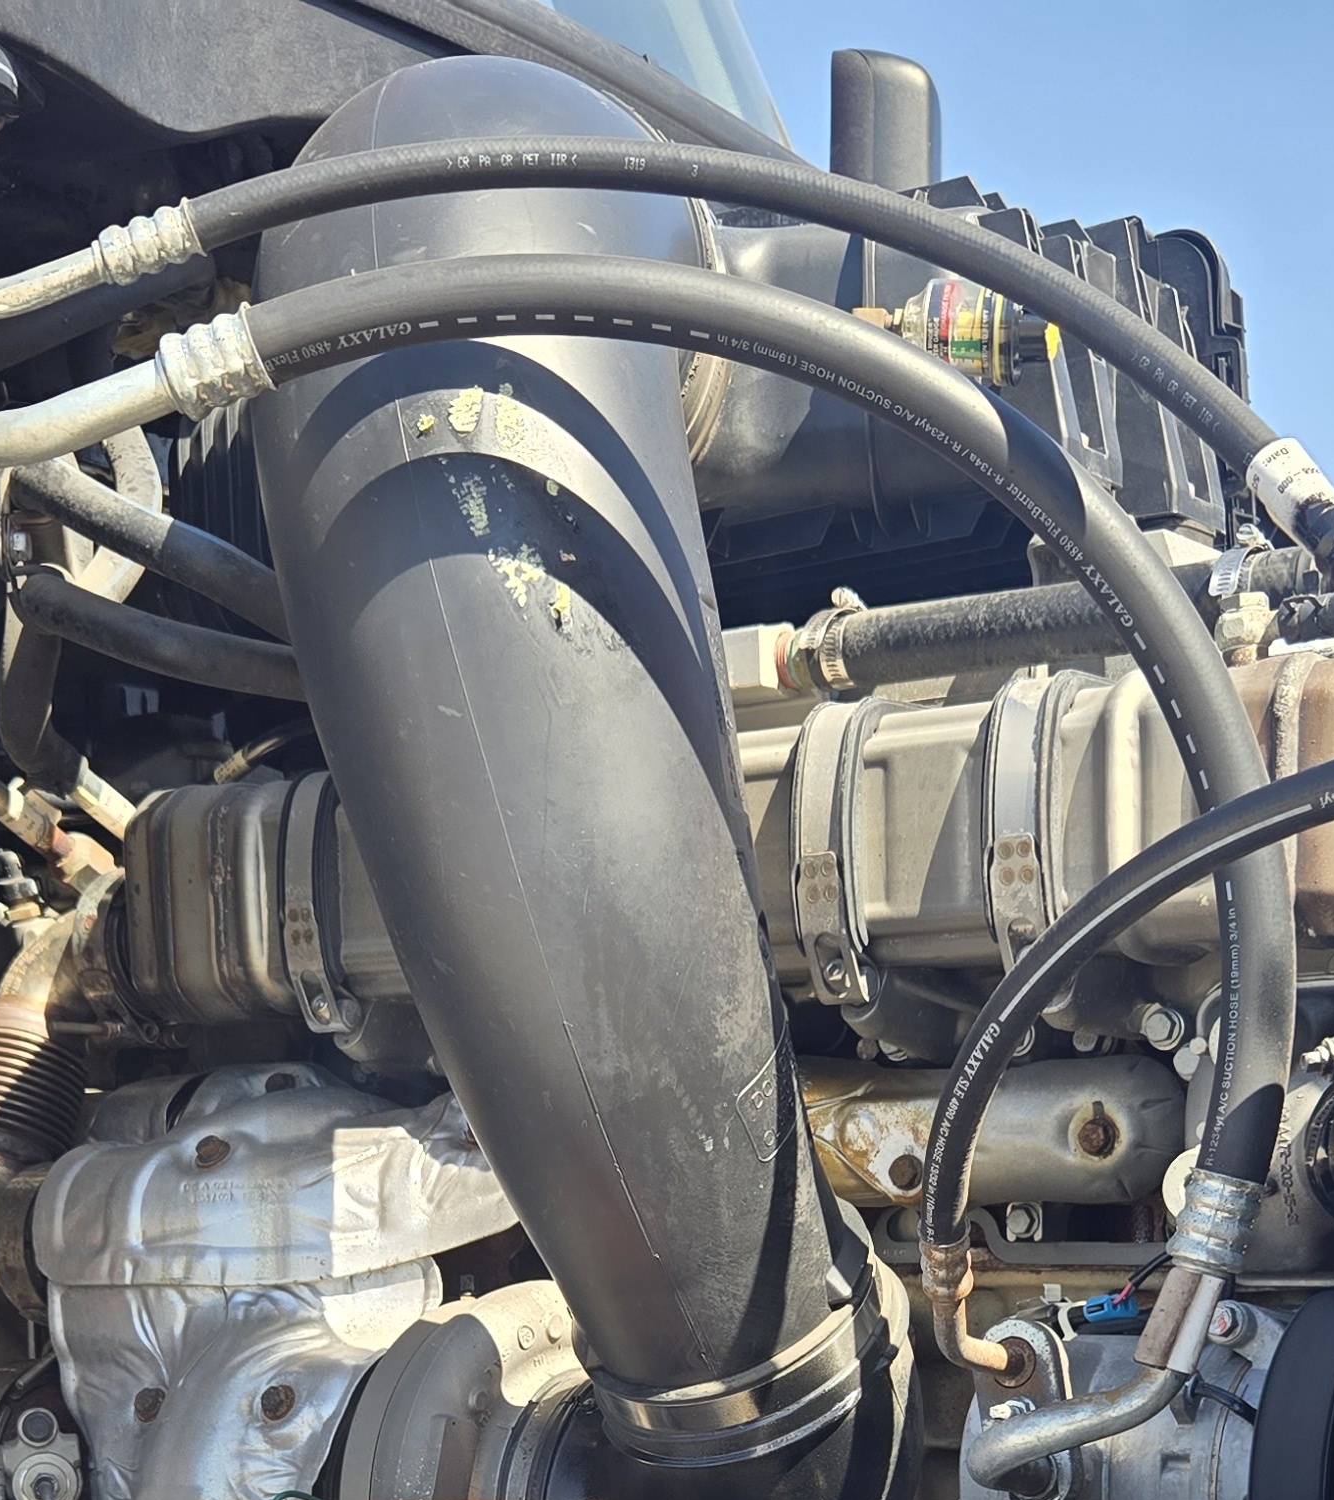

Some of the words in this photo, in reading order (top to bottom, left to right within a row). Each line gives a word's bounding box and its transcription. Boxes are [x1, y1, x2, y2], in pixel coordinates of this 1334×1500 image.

[337, 321, 412, 350] GALAXY
[717, 333, 729, 346] in
[731, 337, 750, 351] 3/4
[302, 340, 331, 359] 4880
[753, 341, 798, 366] (19mm)
[799, 360, 836, 383] HOSE
[837, 376, 892, 411] SUCTION
[893, 404, 916, 422] A/C
[969, 452, 1005, 486] R-134a
[1006, 482, 1062, 539] FlexBarrier
[1059, 534, 1085, 563] 4880
[1081, 563, 1135, 628] GALAXY
[1228, 907, 1236, 920] in
[1228, 921, 1239, 941] 3/4
[1229, 944, 1241, 990] (19mm)
[1228, 992, 1239, 1030] HOSE
[964, 1022, 1001, 1081] GALAXY
[1222, 1032, 1237, 1089] SUCTION
[953, 1075, 970, 1099] SLE
[945, 1097, 960, 1120] 4890
[1218, 1092, 1229, 1115] A/C
[940, 1118, 952, 1137] A/C
[932, 1135, 947, 1164] HOSE
[929, 1162, 940, 1187] 13/32
[925, 1193, 935, 1226] (10mm)
